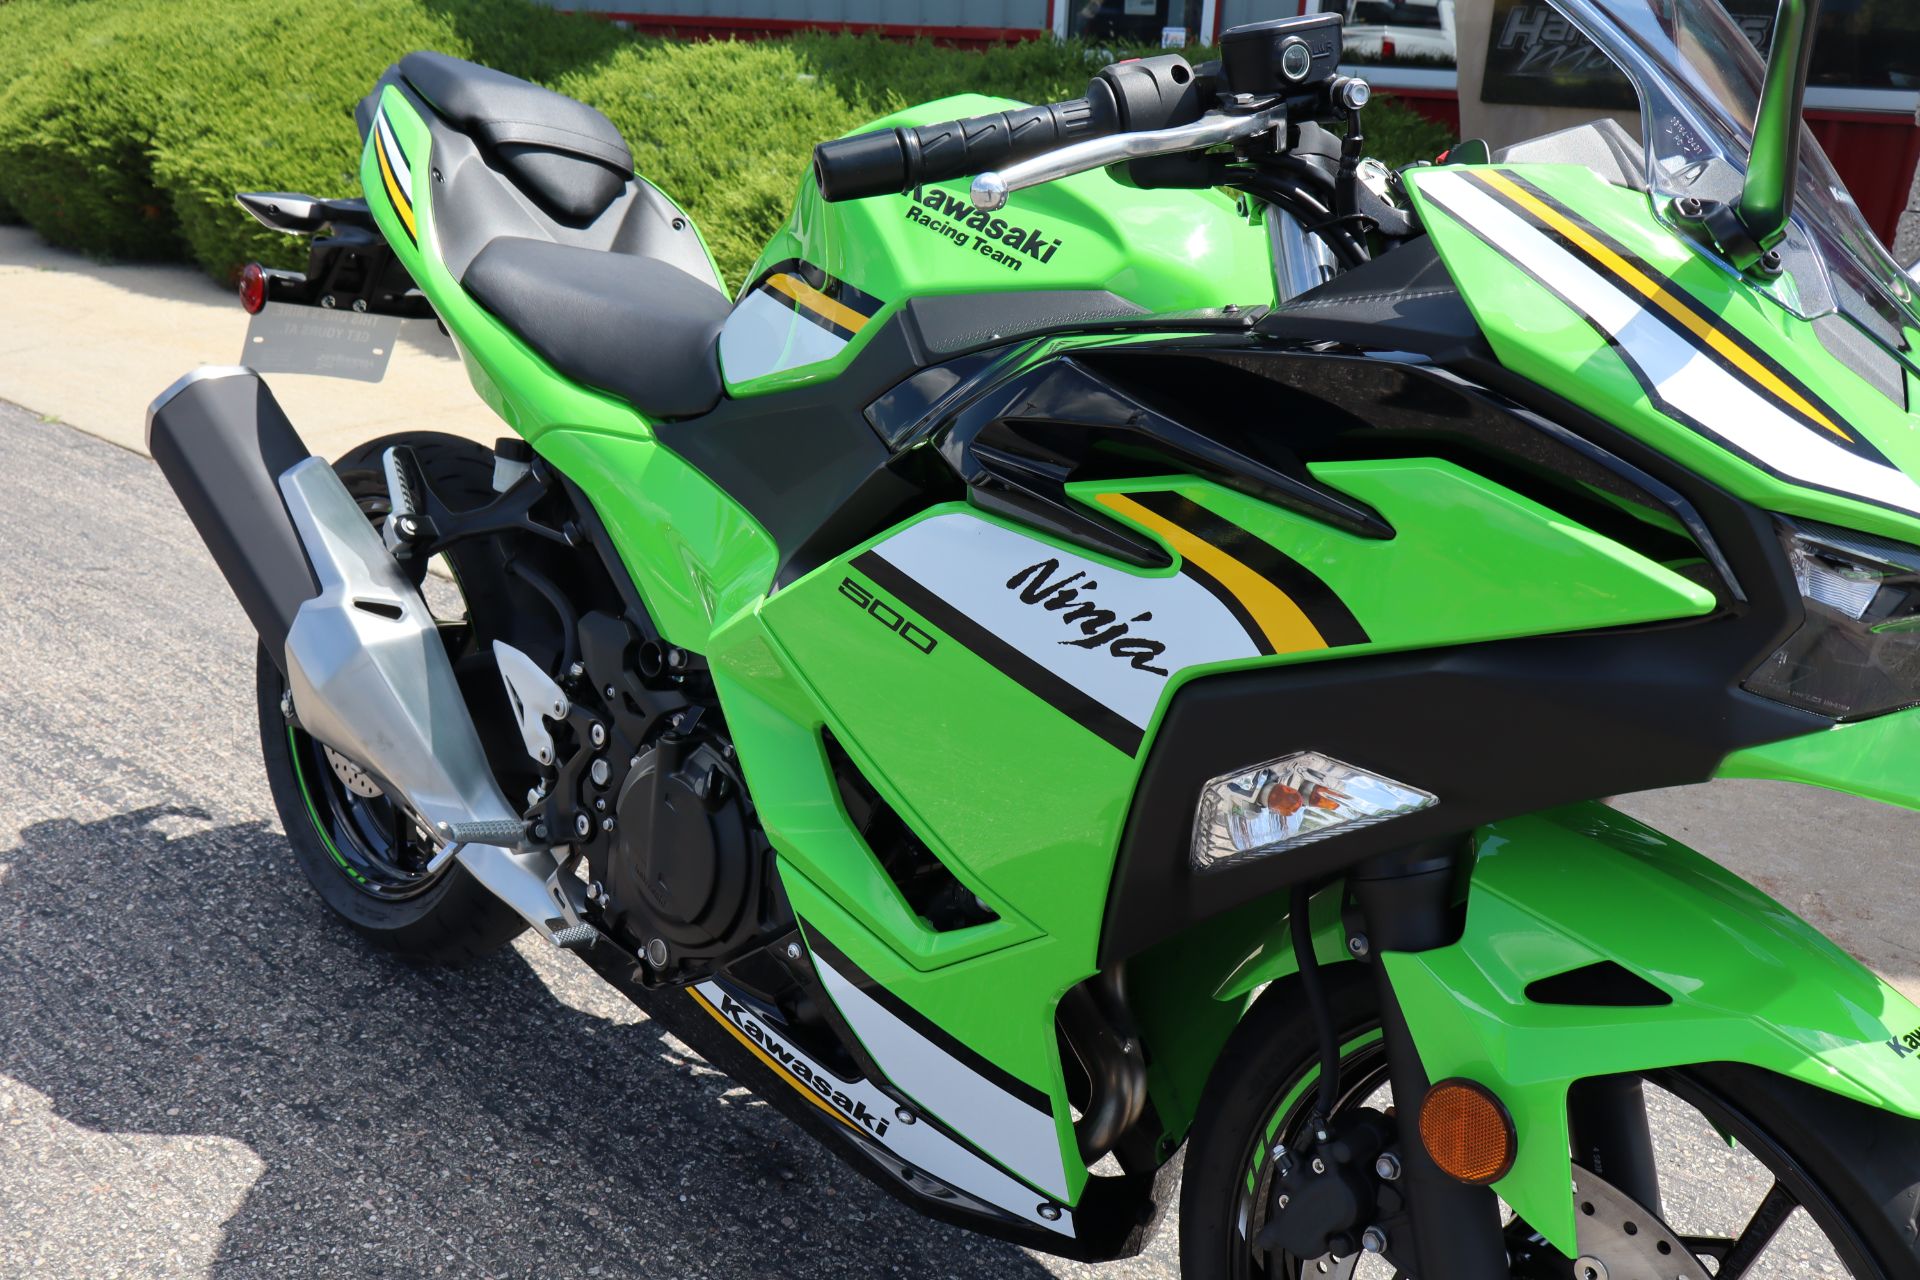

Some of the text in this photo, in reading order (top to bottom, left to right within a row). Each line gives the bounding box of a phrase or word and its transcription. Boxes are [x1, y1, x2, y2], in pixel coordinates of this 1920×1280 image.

[905, 205, 1023, 272] Racing Team
[838, 576, 938, 656] 500
[1006, 558, 1169, 677] Ninja
[720, 993, 891, 1138] Kawasaki
